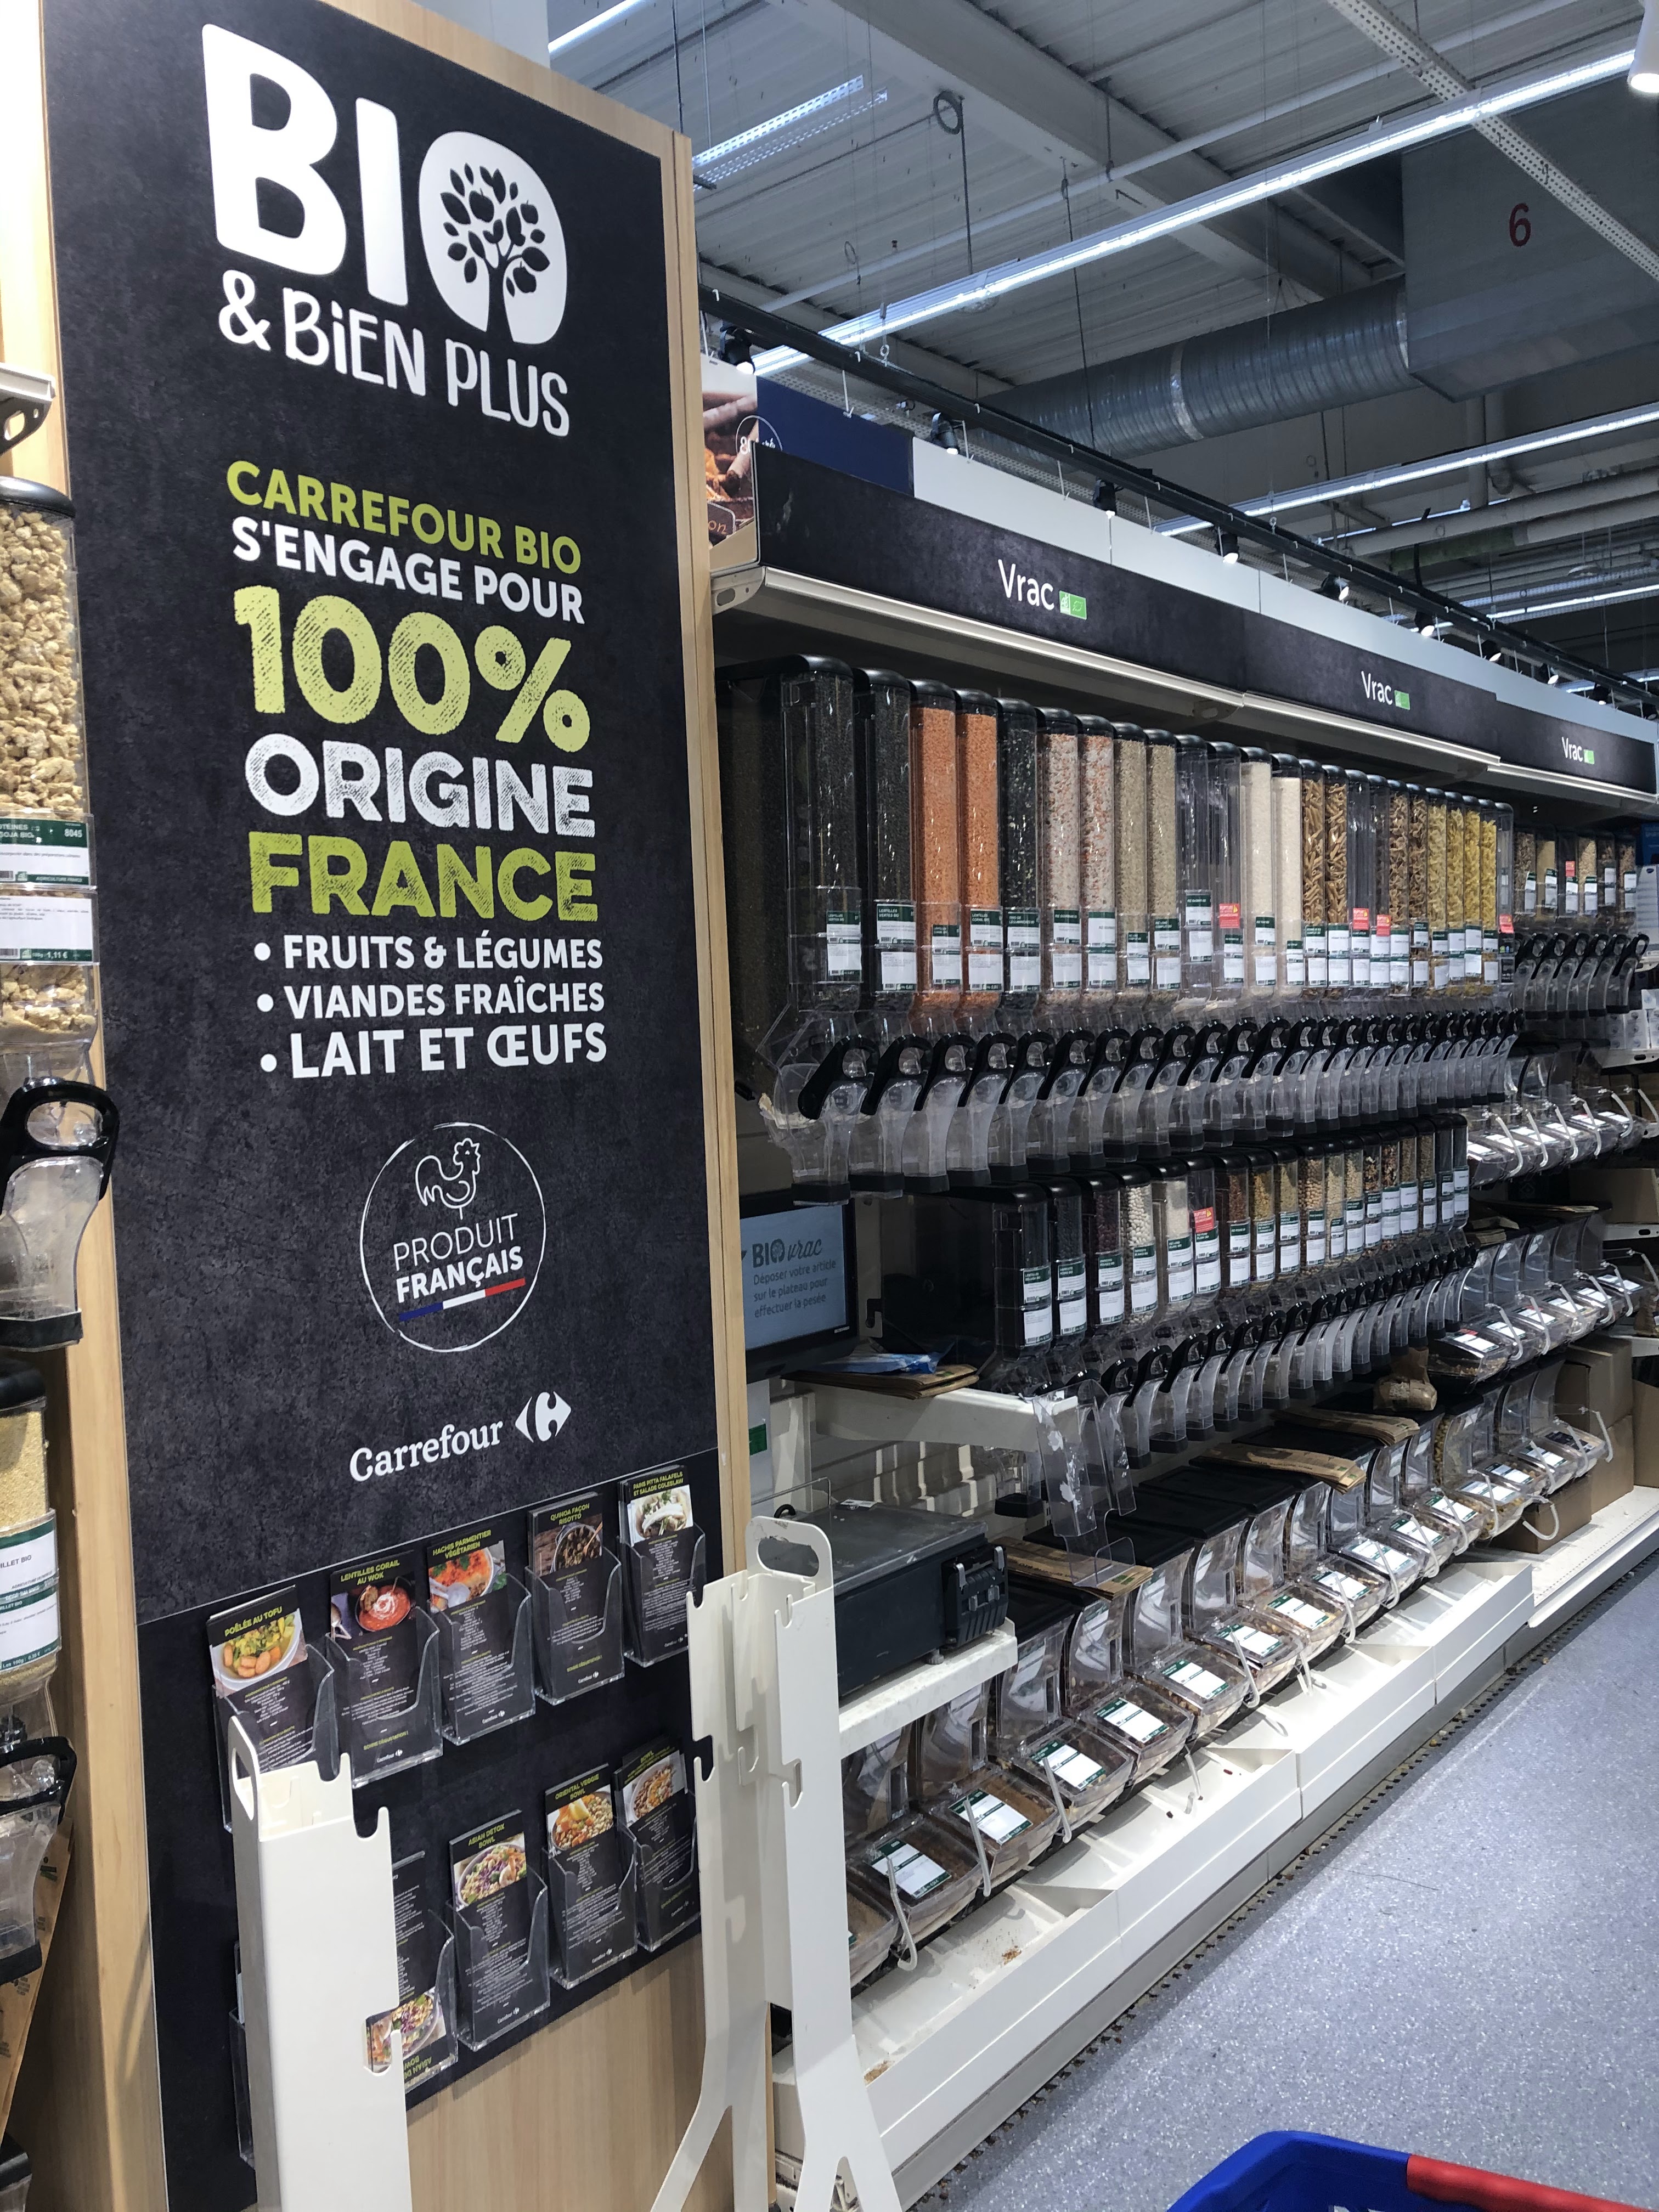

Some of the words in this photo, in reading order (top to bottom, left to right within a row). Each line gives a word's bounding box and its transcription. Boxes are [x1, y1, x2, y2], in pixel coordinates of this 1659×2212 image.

[202, 24, 567, 345] BIO
[1509, 202, 1531, 247] 6
[219, 269, 272, 352] &
[445, 337, 569, 437] PLUS
[227, 460, 504, 559] CARREFOUR
[515, 526, 582, 575] BIO
[232, 516, 463, 601] S'ENGAGE
[475, 567, 585, 625] POUR
[997, 558, 1055, 611] Vrac
[233, 584, 591, 753] 100%
[1361, 670, 1393, 706] Vrac
[1561, 736, 1583, 762] Vrac
[245, 733, 596, 838] ORIGINE
[249, 831, 598, 922] FRANCE
[283, 934, 414, 969] FRUITS
[424, 936, 447, 969] &
[456, 929, 603, 969] LÉGUMES
[284, 983, 445, 1019] VIANDES
[454, 976, 605, 1016] FRAÎCHES
[290, 1029, 405, 1079] LAIT
[419, 1026, 474, 1072] ET
[487, 1022, 607, 1068] ŒUFS
[393, 1212, 518, 1271] PRODUIT
[752, 1238, 785, 1268] BIO
[787, 1238, 823, 1262] vrac
[396, 1245, 524, 1304] FRANÇAIS
[754, 1270, 787, 1285] Déposer
[789, 1266, 810, 1278] votre
[812, 1259, 837, 1273] article
[754, 1291, 766, 1302] sur
[769, 1288, 776, 1299] le
[778, 1283, 808, 1299] plateau
[810, 1277, 828, 1290] pour
[754, 1301, 793, 1318] effectuer
[794, 1299, 801, 1308] la
[803, 1292, 826, 1309] pesée
[349, 1419, 504, 1482] Carrefour
[659, 1471, 683, 1482] FALAFELS
[550, 1509, 571, 1521] QUINOA
[572, 1503, 590, 1514] FAÇON
[558, 1513, 582, 1525] RISOTTO
[433, 1542, 455, 1556] HACHIS
[455, 1529, 492, 1548] PARMENTIER
[444, 1541, 481, 1559] VÉGÉTARIEN
[1, 1559, 19, 1568] ILLET
[21, 1554, 32, 1563] BIO
[340, 1566, 375, 1582] LENTILLES
[375, 1559, 400, 1573] CORAIL
[357, 1577, 368, 1585] AU
[368, 1572, 384, 1583] WOK
[224, 1618, 252, 1637] POÊLÉE
[252, 1614, 263, 1625] AU
[264, 1606, 283, 1620] TOFU
[555, 1784, 580, 1801] ORIENTAL
[580, 1773, 600, 1788] VEGGIE
[569, 1790, 586, 1801] BOWL
[468, 1831, 485, 1847] ASIAN
[484, 1823, 505, 1838] DETOX
[478, 1836, 495, 1849] BOWL
